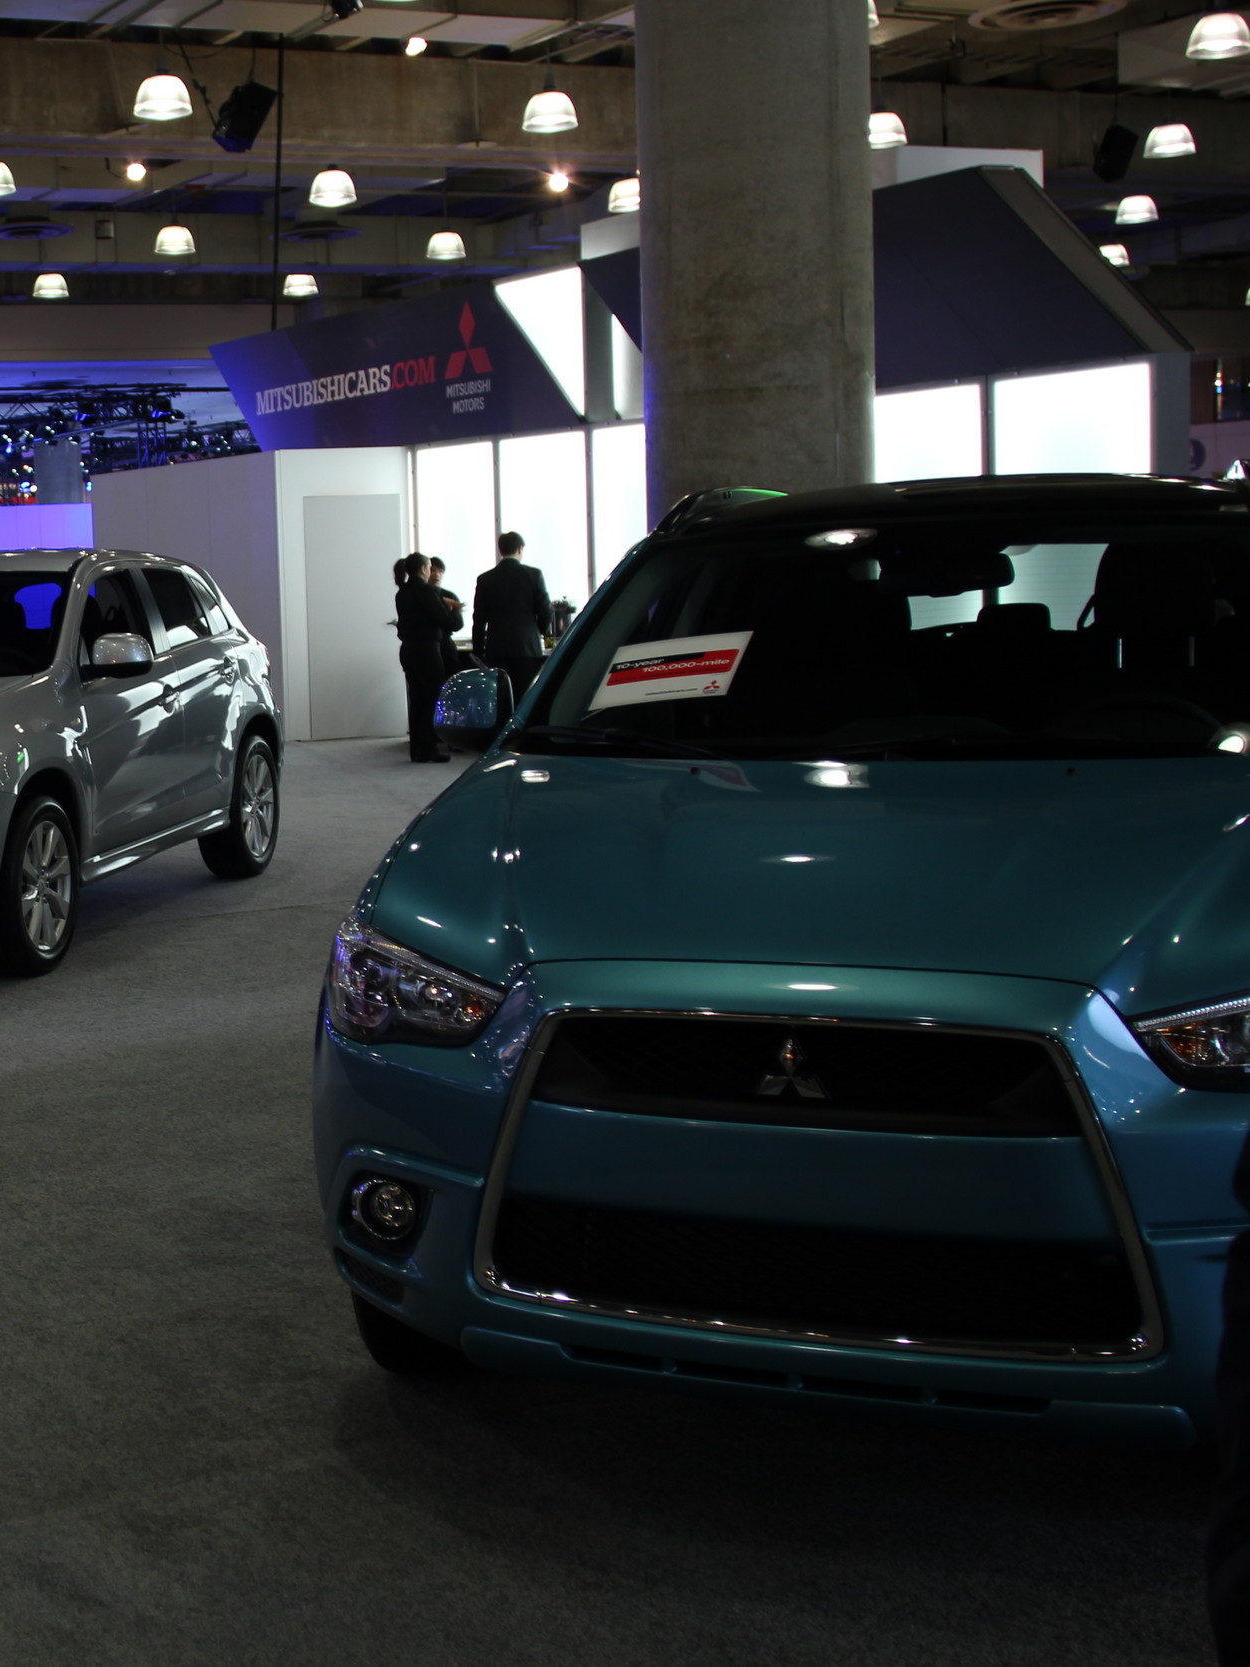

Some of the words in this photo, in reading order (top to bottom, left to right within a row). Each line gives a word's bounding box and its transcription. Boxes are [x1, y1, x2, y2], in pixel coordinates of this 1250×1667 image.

[256, 357, 436, 415] MITSUBISHICARS.COM
[446, 379, 491, 399] MITSUBISHI
[452, 398, 485, 414] MOTORS
[615, 658, 665, 670] 10-year
[642, 659, 731, 673] 100,000-mile
